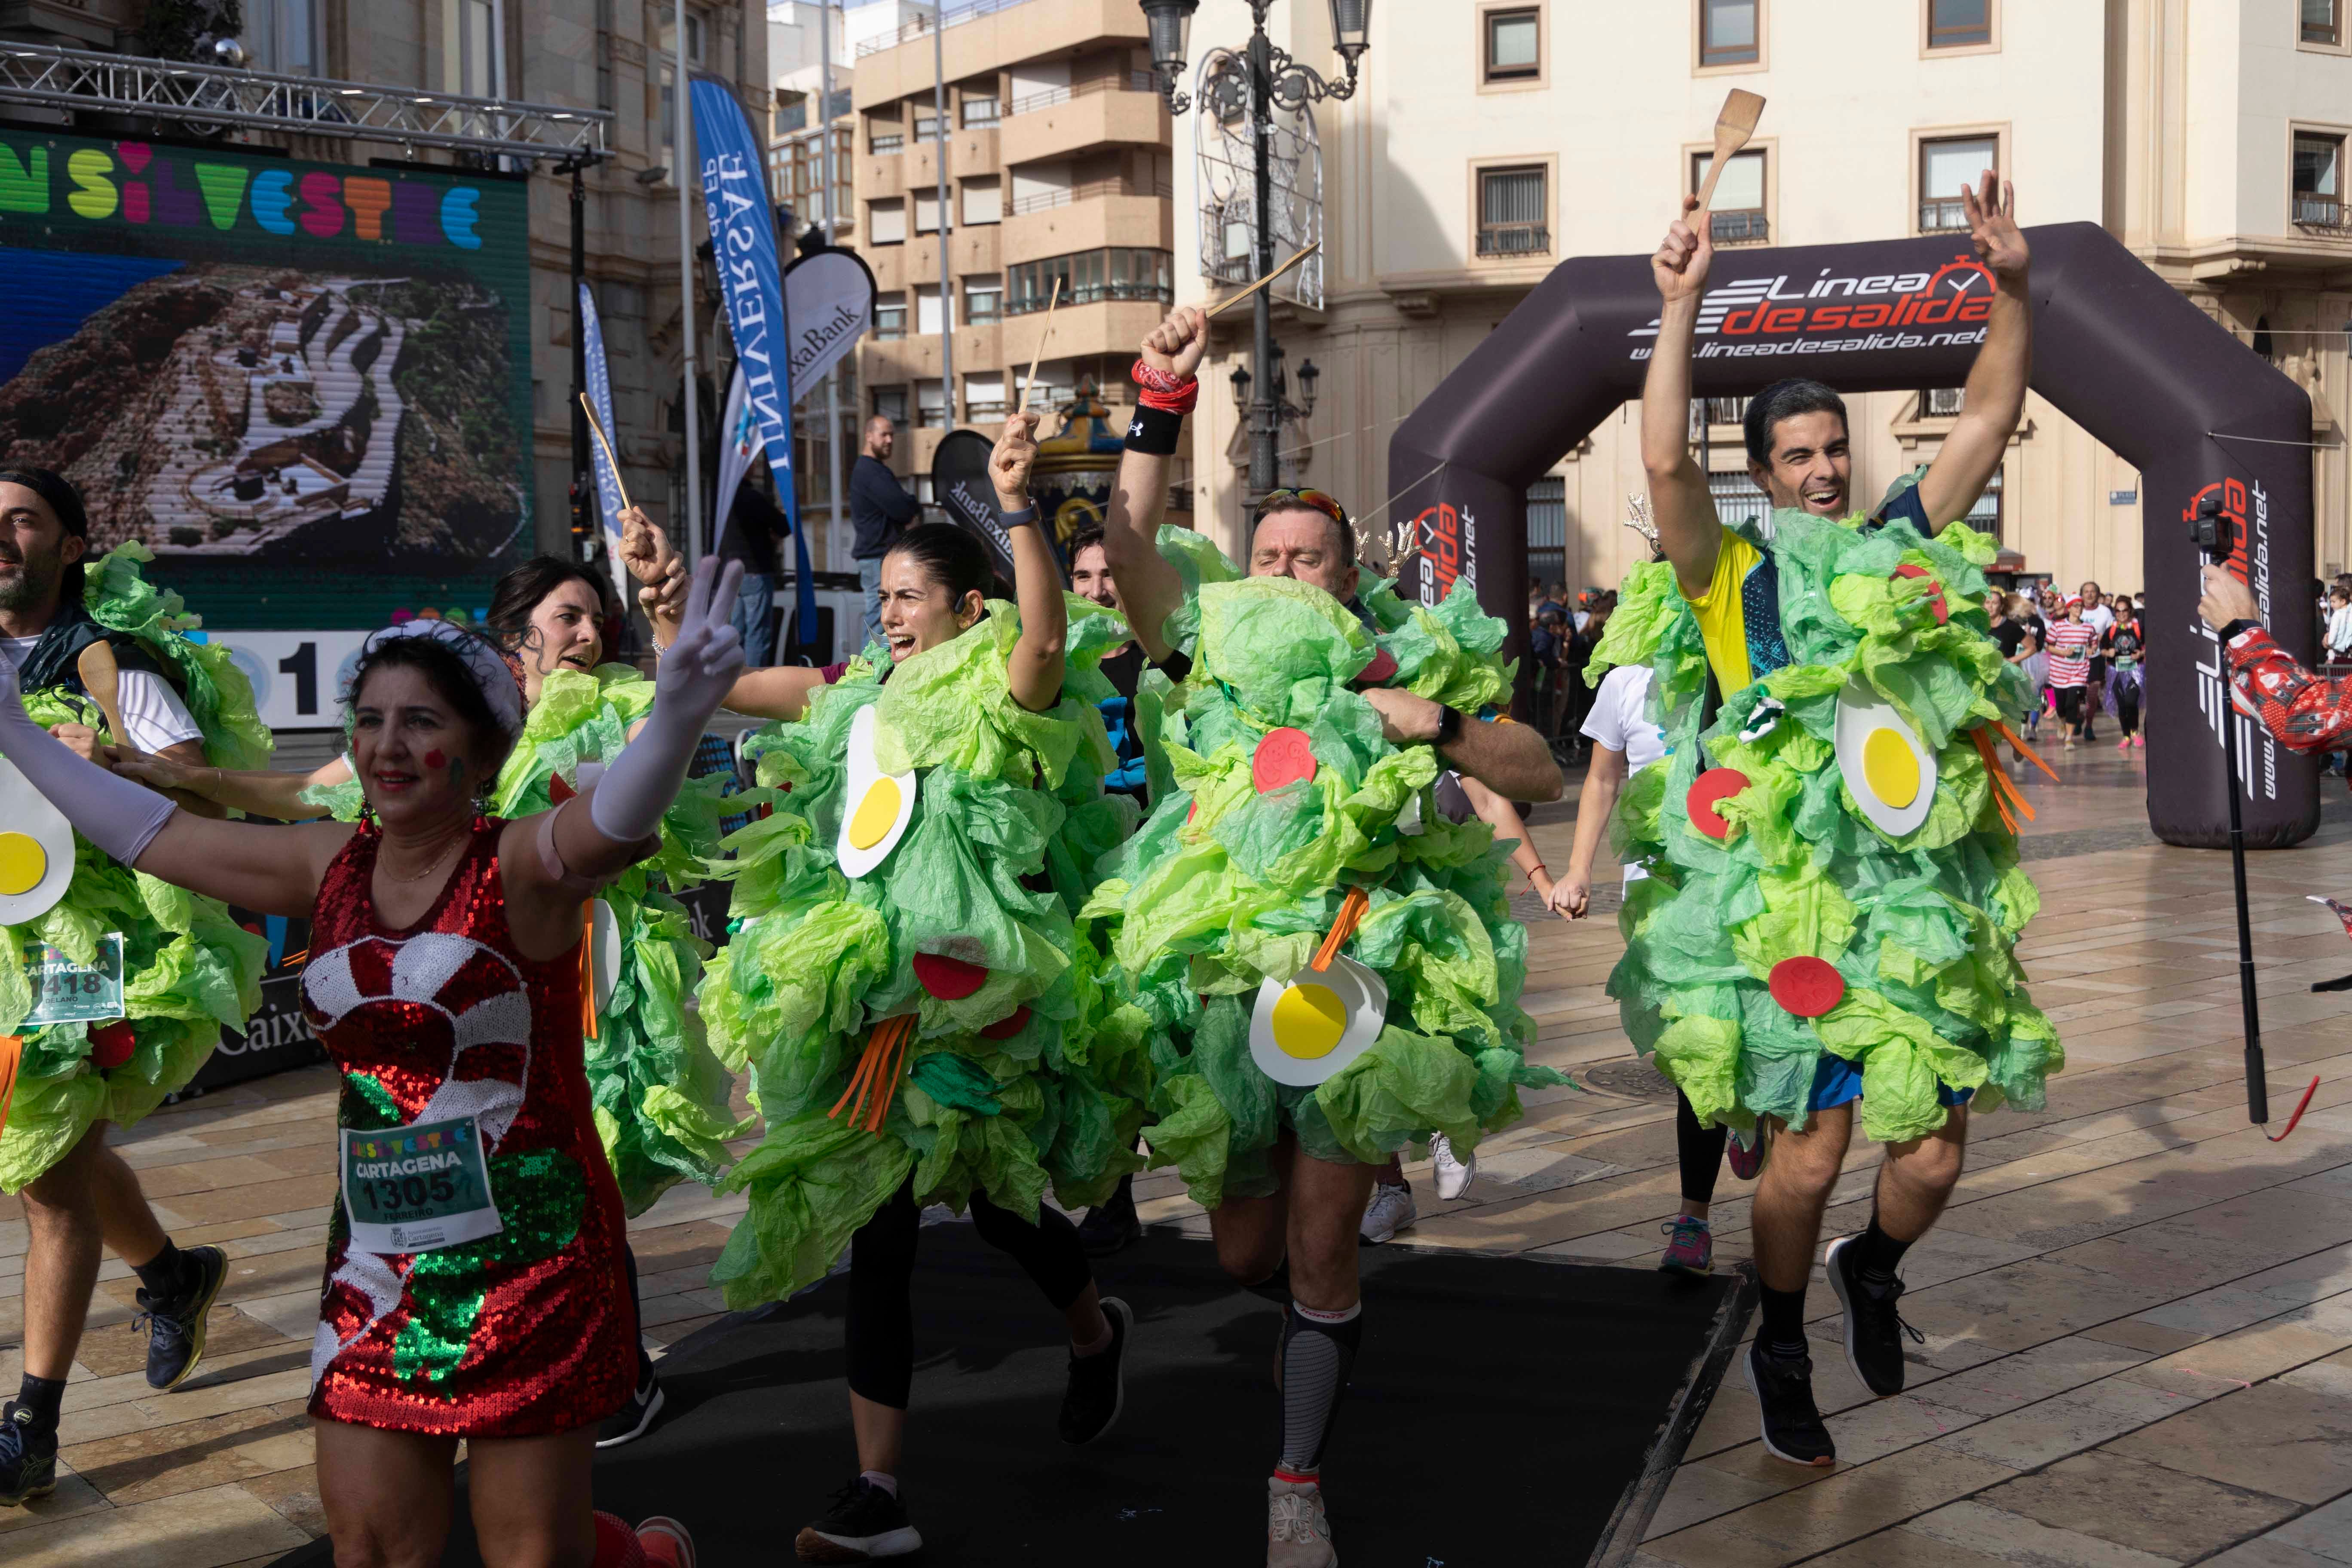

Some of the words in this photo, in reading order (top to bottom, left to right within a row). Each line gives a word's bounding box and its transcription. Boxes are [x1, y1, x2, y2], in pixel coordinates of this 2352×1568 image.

[791, 305, 861, 377] xaBank
[1629, 327, 1988, 360] w.lineadesalida.net
[279, 642, 318, 715] 1
[356, 1151, 462, 1179] CARTAGENA
[363, 1170, 455, 1211] 1305
[384, 1207, 433, 1222] FERREIRO
